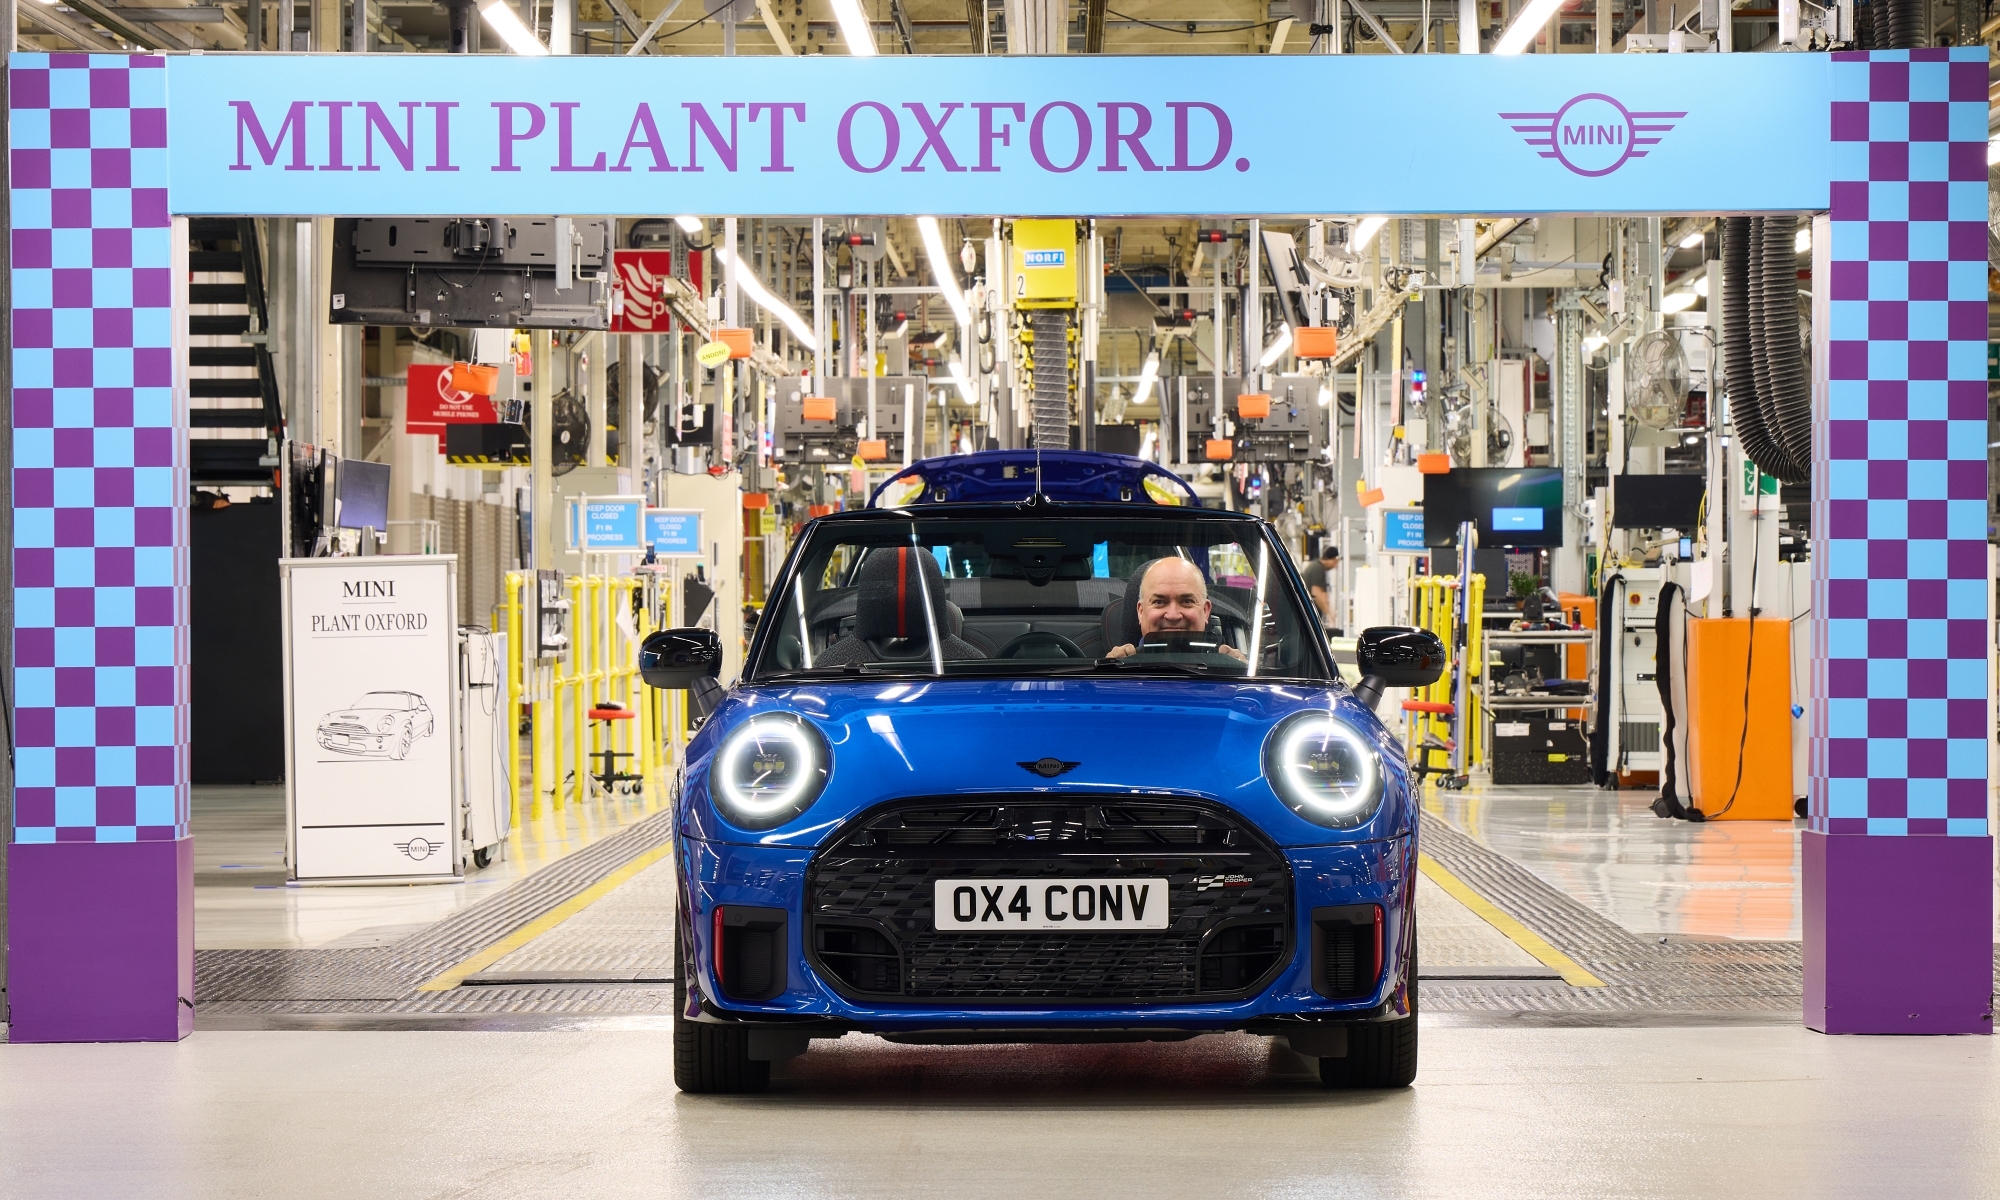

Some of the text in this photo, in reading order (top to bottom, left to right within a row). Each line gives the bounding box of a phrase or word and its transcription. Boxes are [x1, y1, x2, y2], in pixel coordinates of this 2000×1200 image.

[229, 100, 1250, 173] MINI PLANT OXFORD.
[1563, 125, 1623, 145] MINI
[1025, 252, 1064, 263] NORFI
[1017, 275, 1025, 295] 2
[701, 348, 727, 361] ANDON!
[342, 580, 396, 598] MINI
[311, 612, 428, 632] PLANT OXFORD
[953, 884, 1150, 922] OX4 CONV
